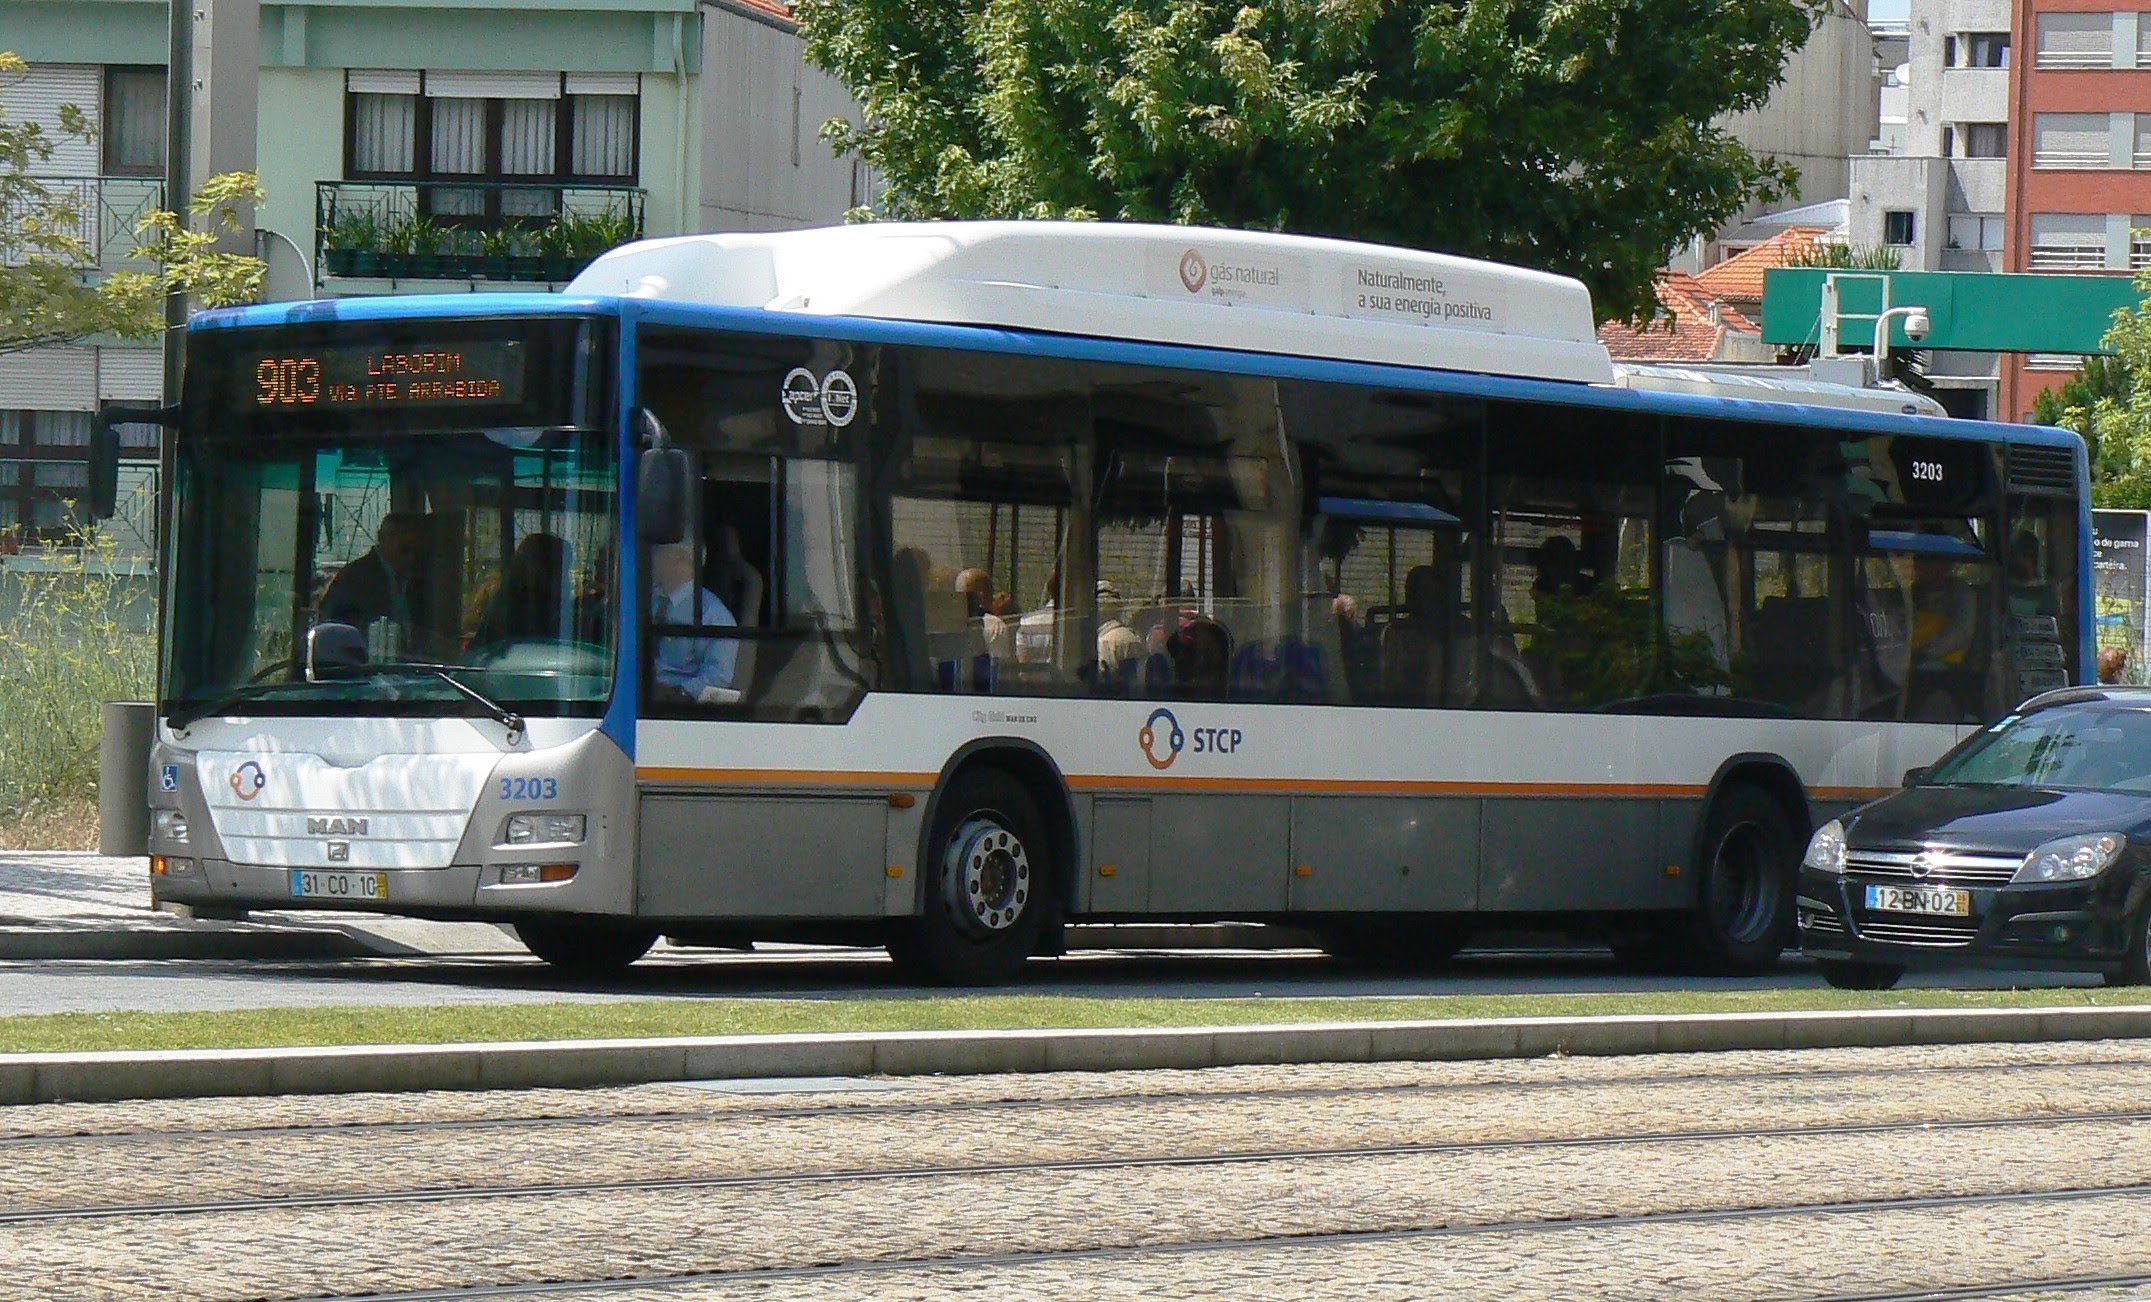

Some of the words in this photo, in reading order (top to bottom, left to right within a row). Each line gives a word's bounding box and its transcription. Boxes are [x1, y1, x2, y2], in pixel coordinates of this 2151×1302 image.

[1210, 262, 1232, 284] gás
[1236, 267, 1279, 286] natural
[1358, 269, 1446, 297] Naturalmente,
[1358, 294, 1366, 308] a
[1370, 295, 1391, 311] sua
[1395, 297, 1441, 319] energia
[1444, 301, 1491, 320] positiva
[367, 352, 462, 376] LABORIM
[257, 358, 320, 404] 903
[1912, 461, 1943, 481] 3203
[2101, 537, 2113, 548] de
[2113, 540, 2139, 550] gama
[1193, 727, 1242, 753] STCP
[499, 777, 558, 800] 3203
[307, 817, 368, 835] MAN
